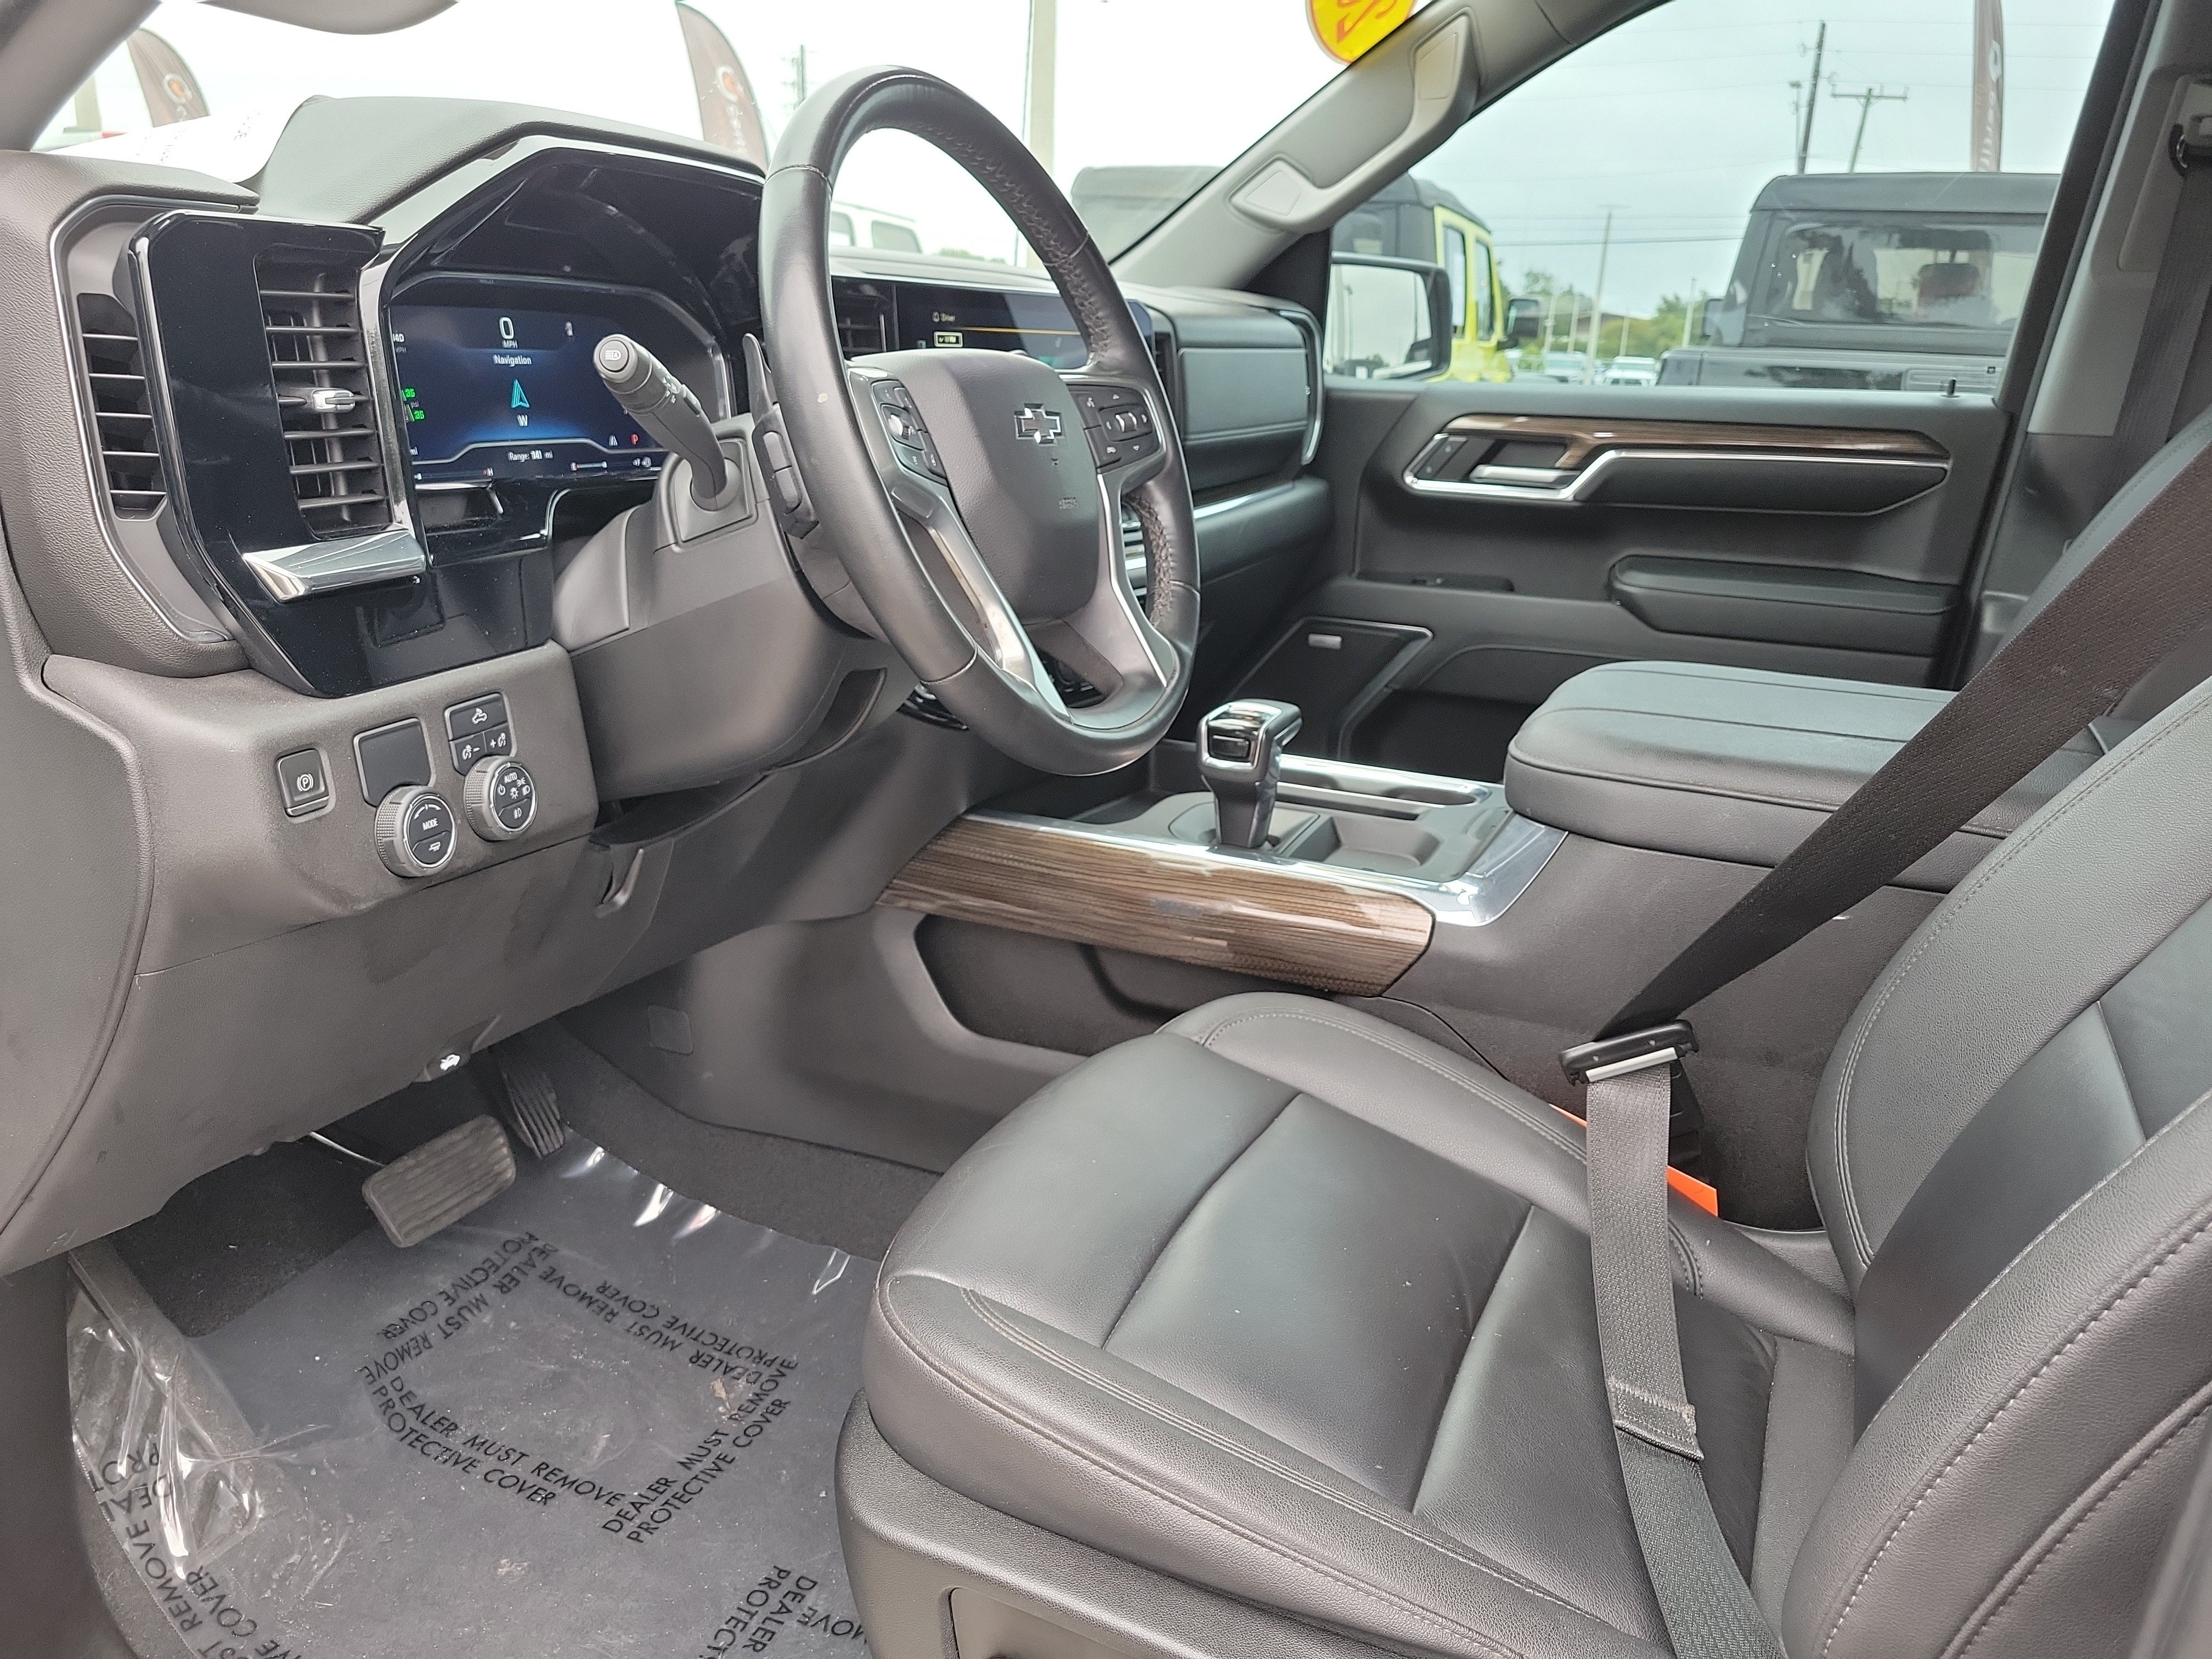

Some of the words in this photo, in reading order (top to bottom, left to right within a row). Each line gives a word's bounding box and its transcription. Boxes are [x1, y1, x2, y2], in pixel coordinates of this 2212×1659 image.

[499, 317, 514, 339] 0
[503, 340, 518, 348] MPH
[494, 354, 532, 366] Navigation
[517, 415, 528, 426] W
[508, 451, 529, 462] Range:
[504, 772, 517, 783] AUTO
[422, 818, 438, 830] MODE
[538, 1266, 619, 1323] REMOVE
[597, 1280, 659, 1319] COVER
[376, 1301, 438, 1339] COVER
[438, 1293, 489, 1339] MUST
[623, 1322, 682, 1352] MUST
[359, 1332, 433, 1385] REMOVE
[662, 1316, 780, 1368] PROTECTIVE
[689, 1350, 762, 1385] DEALER
[372, 1385, 483, 1474] PROTECTIVE
[483, 1469, 557, 1506] COVER
[390, 1375, 459, 1438] DEALER
[462, 1434, 529, 1466] MUST
[530, 1461, 626, 1507] REMOVE
[602, 1477, 679, 1533] DEALER
[676, 1429, 730, 1471] MUST
[728, 1359, 798, 1423] REMOVE
[627, 1453, 736, 1543] PROTECTIVE
[732, 1398, 791, 1448] COVER
[126, 1520, 203, 1633] REMOVE
[186, 1565, 257, 1637] COVER
[742, 1576, 819, 1653] DEALER
